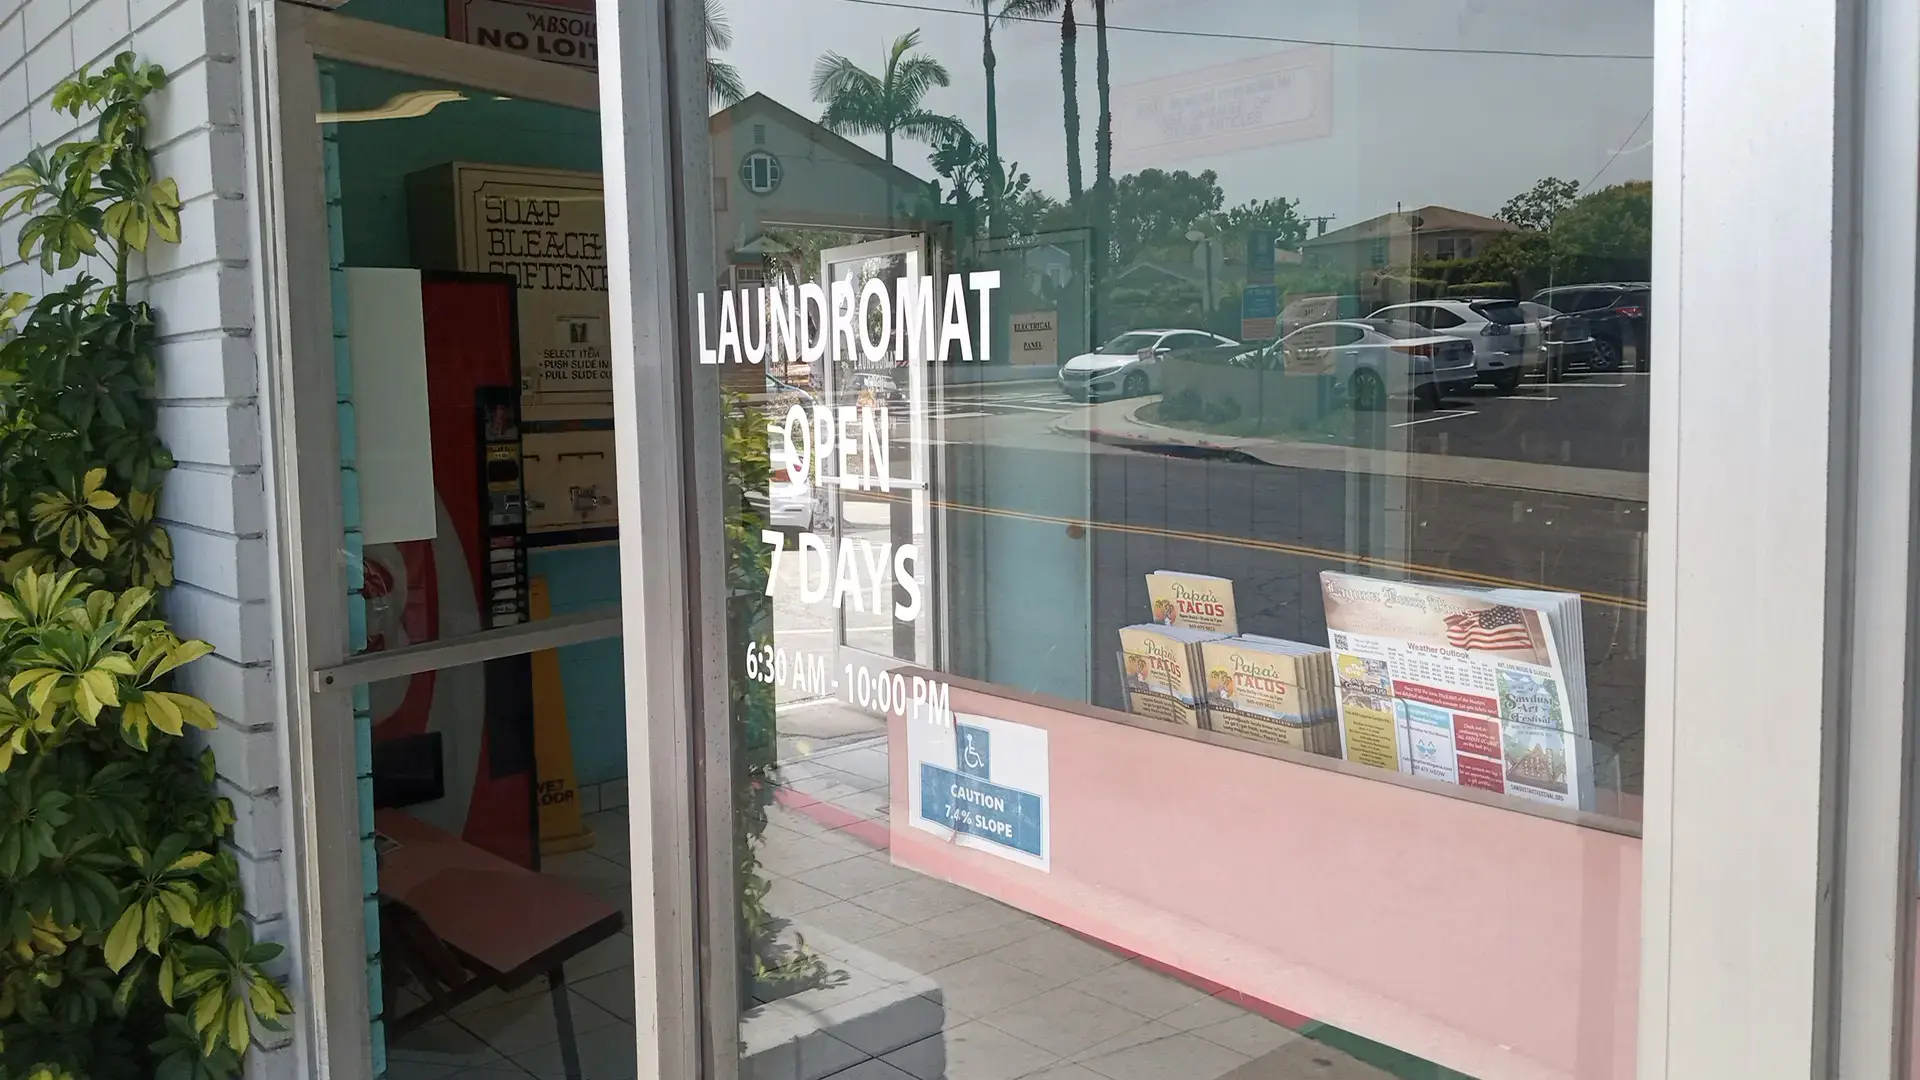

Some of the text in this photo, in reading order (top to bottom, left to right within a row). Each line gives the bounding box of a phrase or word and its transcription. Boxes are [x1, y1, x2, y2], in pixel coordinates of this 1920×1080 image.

[477, 27, 528, 50] NO
[485, 195, 560, 226] SOAP
[487, 229, 603, 260] BLEACH
[697, 270, 1000, 365] LAUNDROMAT
[1014, 321, 1052, 332] ELECTRICAL
[544, 349, 600, 359] SELECT ITEM
[1024, 341, 1043, 351] PANEL
[544, 360, 609, 370] PUSH SLIDE IN
[545, 370, 568, 380] PULL
[572, 370, 597, 380] SLIDE
[786, 404, 889, 493] OPEN
[762, 529, 922, 622] 7 DAYS
[1171, 582, 1219, 606] Papa's
[1176, 600, 1225, 617] TACOS
[1144, 638, 1177, 663] Papa's
[1407, 642, 1470, 659] Weather Outlook
[1149, 656, 1182, 678] TACOS
[1229, 653, 1280, 678] Papa's
[745, 641, 787, 686] 6:30
[792, 651, 826, 697] AM
[845, 663, 906, 717] 10:00
[913, 680, 950, 729] PM
[1233, 672, 1286, 695] TACOS
[1345, 681, 1362, 691] Come
[1505, 693, 1553, 710] Sawdust
[1518, 704, 1539, 713] Art
[1511, 712, 1551, 724] Festival
[950, 784, 1005, 813] CAUTION
[945, 804, 1013, 838] 7.4% SLOPE
